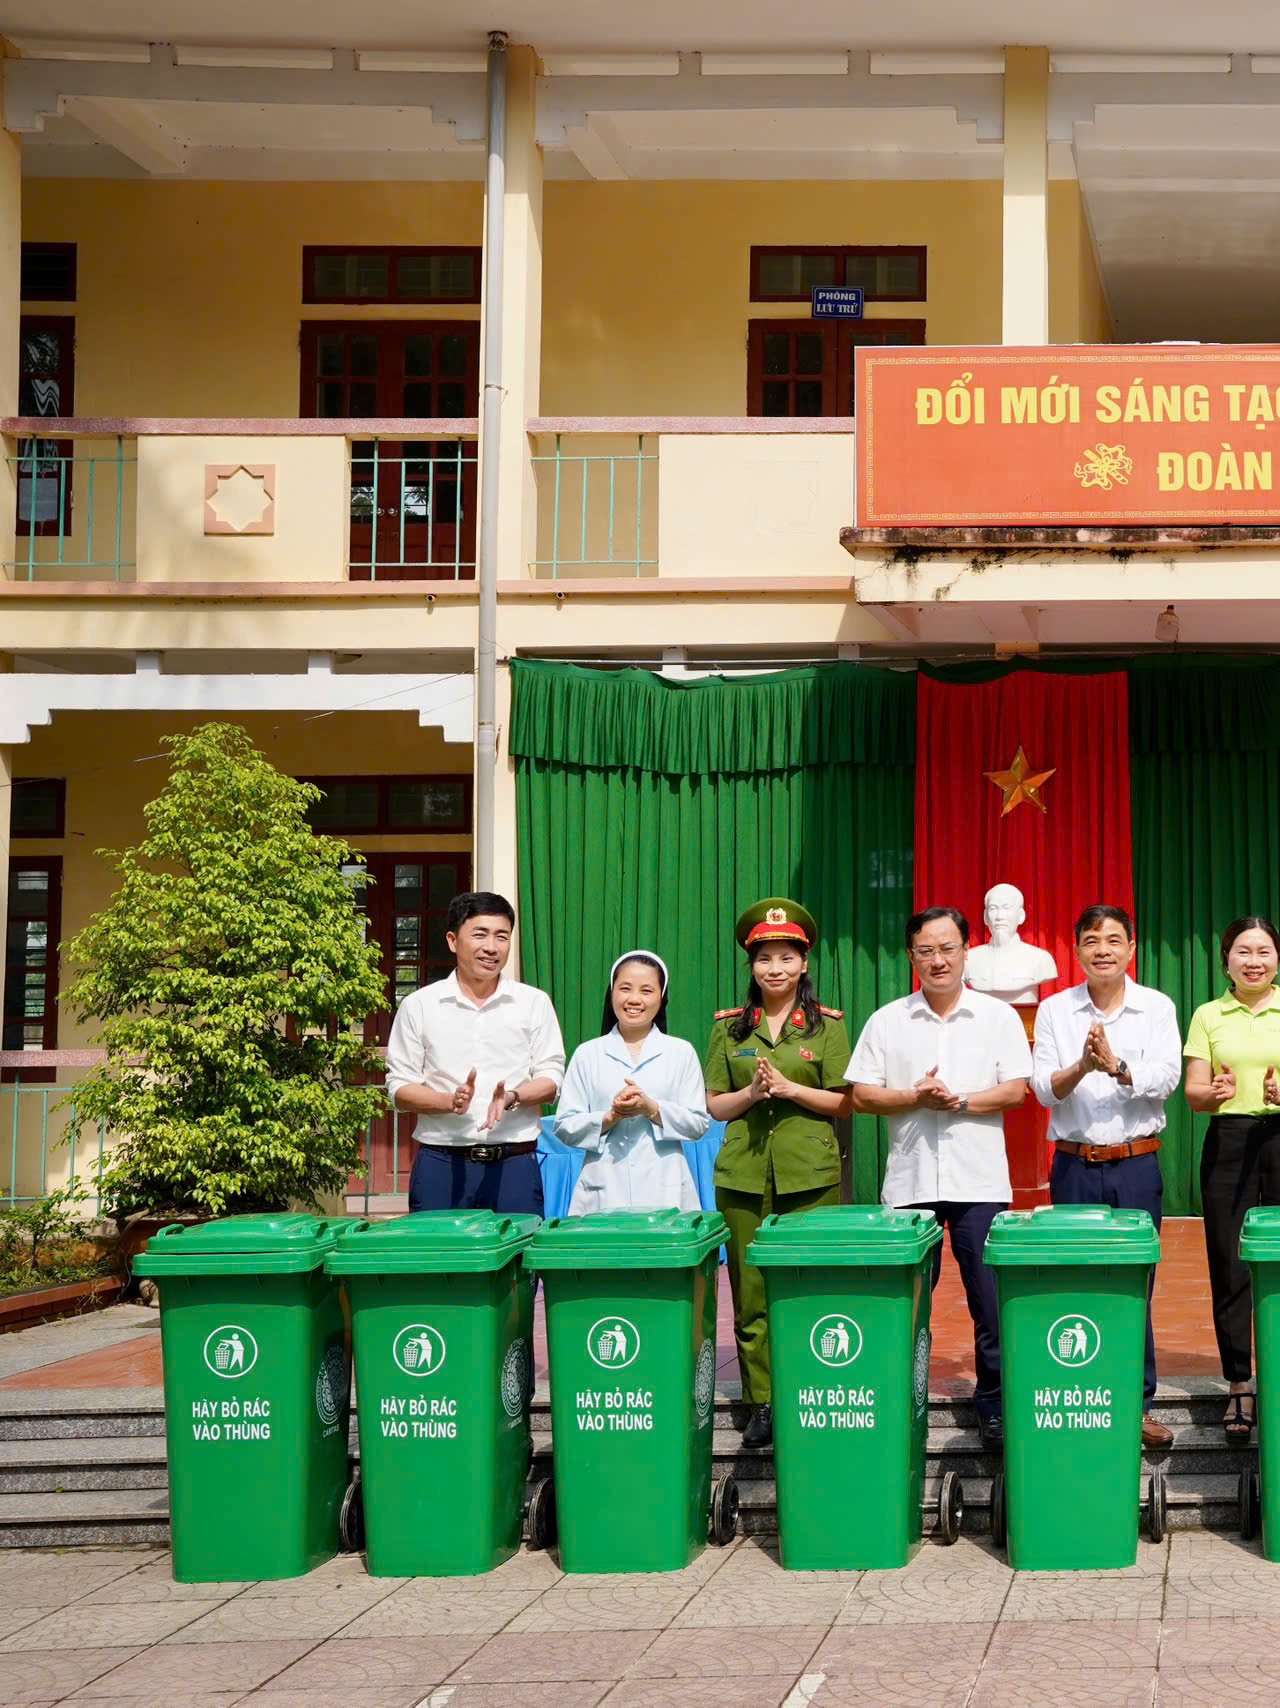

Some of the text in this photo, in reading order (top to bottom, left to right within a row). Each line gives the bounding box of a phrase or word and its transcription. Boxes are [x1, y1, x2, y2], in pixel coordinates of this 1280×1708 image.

[818, 291, 856, 301] PHÒNG
[816, 302, 858, 314] LƯU TRỮ
[916, 372, 985, 425] ĐỔI
[1001, 376, 1081, 424] MỚI
[1096, 377, 1210, 423] SÁNG
[1157, 443, 1273, 491] ĐOÀN
[380, 1394, 457, 1417] HÃY BỎ RÁC
[576, 1386, 653, 1409] HÃY BỎ RÁC
[799, 1384, 875, 1407] HÃY BỎ RÁC
[1034, 1384, 1112, 1407] HÃY BỎ RÁC
[192, 1396, 271, 1418] HÃY BỎ RÁC
[799, 1407, 875, 1429] VÀO THÙNG
[1034, 1407, 1112, 1429] VÀO THÙNG
[192, 1420, 271, 1441] VÀO THÙNG
[380, 1416, 457, 1439] VÀO THÙNG
[576, 1410, 654, 1431] VÀO THÙNG
